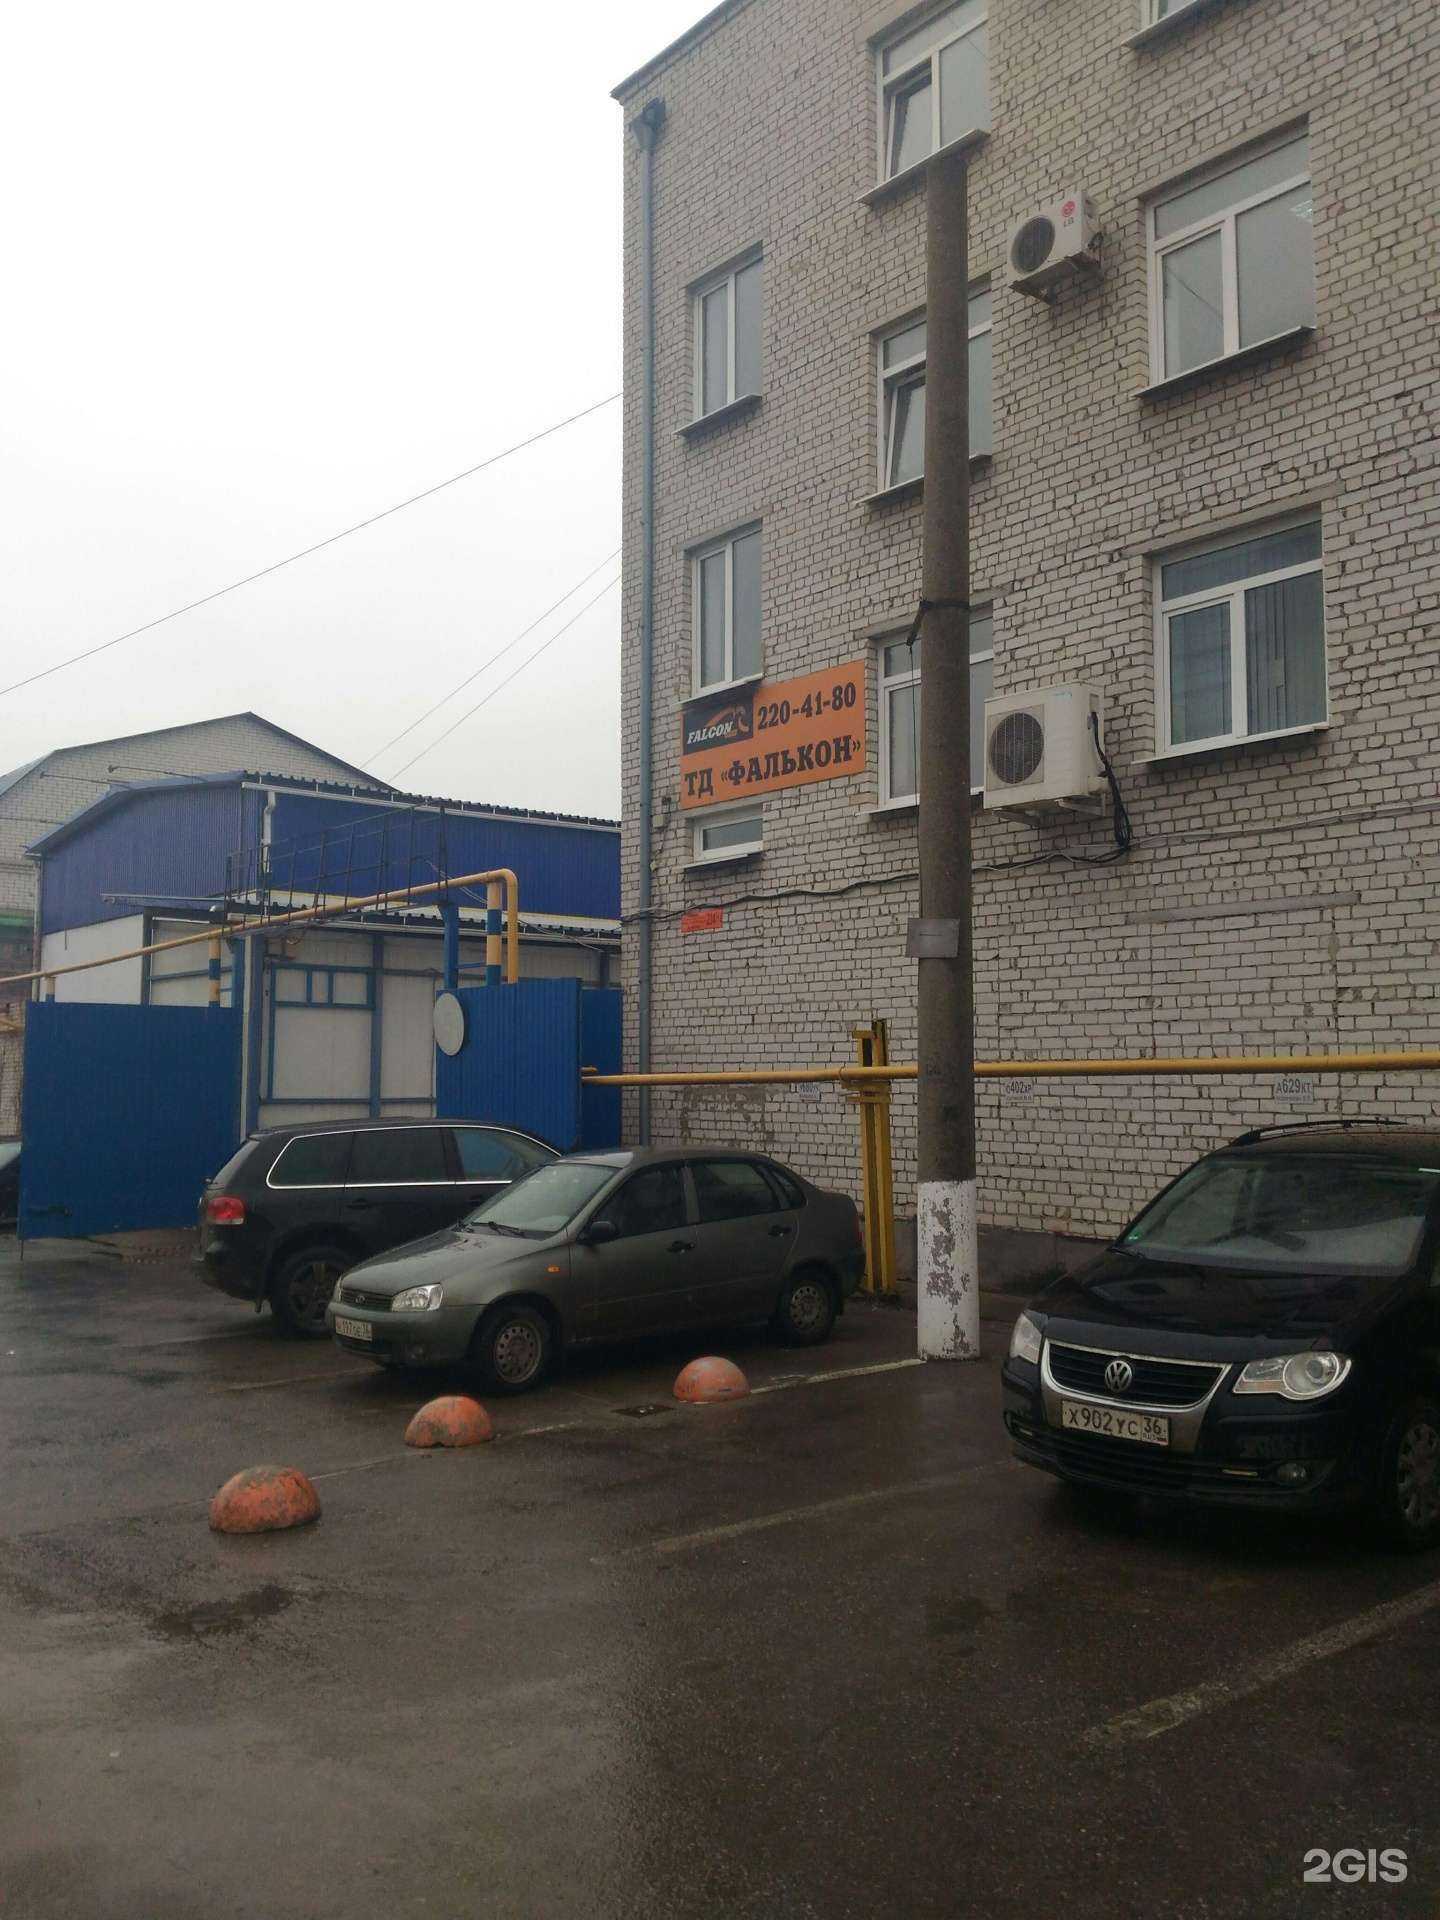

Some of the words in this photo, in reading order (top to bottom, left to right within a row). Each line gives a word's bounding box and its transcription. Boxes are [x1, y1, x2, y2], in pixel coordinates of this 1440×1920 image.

[757, 682, 856, 730] 220-41-80
[686, 719, 734, 745] FALCON
[685, 767, 714, 799] ТД
[720, 734, 861, 787] «ФАЛЬКОН»
[1068, 1407, 1138, 1436] Х902УС
[1143, 1416, 1161, 1435] 36
